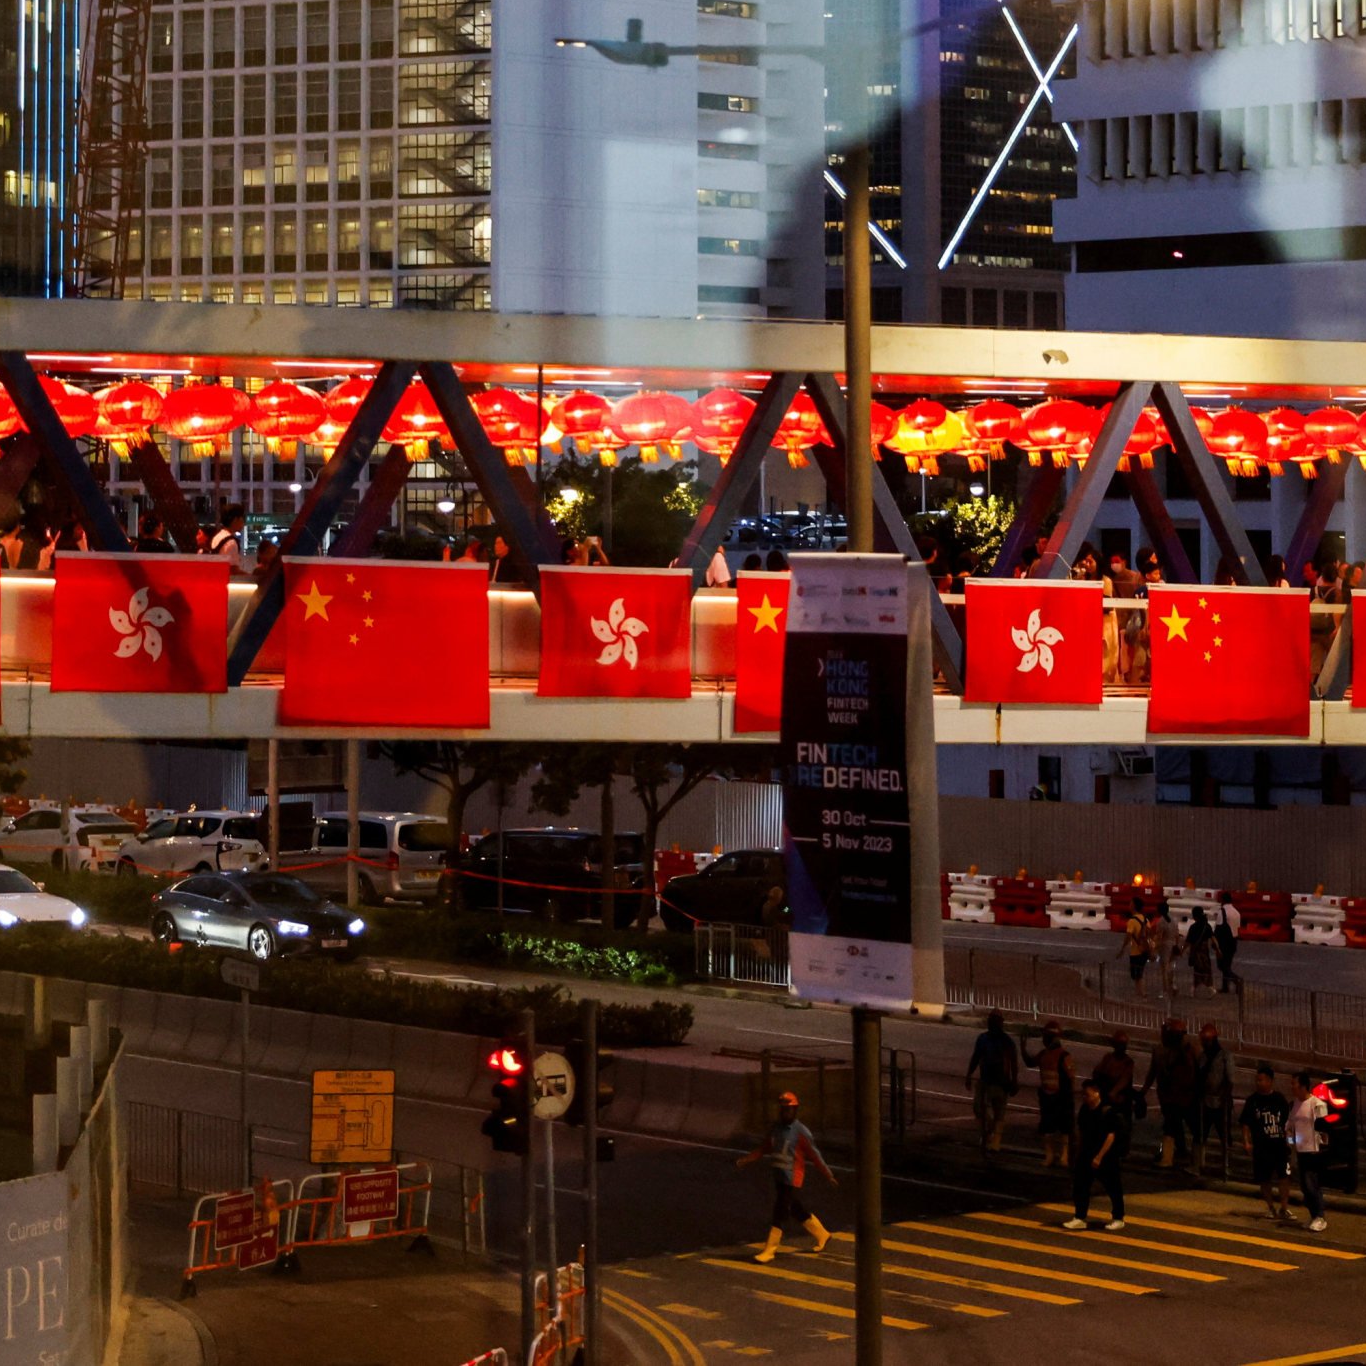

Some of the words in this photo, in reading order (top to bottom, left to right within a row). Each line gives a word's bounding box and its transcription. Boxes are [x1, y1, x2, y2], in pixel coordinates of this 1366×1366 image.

[826, 660, 869, 677] HONG
[826, 678, 869, 697] KONG
[826, 697, 870, 711] FINTECH
[827, 711, 859, 724] WEEK
[796, 742, 878, 766] FINTECH
[797, 766, 904, 792] REDEFINED.
[821, 809, 841, 826] 30
[843, 810, 867, 827] Oct
[822, 834, 832, 849] 5
[835, 835, 860, 850] Nov
[862, 835, 893, 853] 2023
[6, 1220, 51, 1242] Curate
